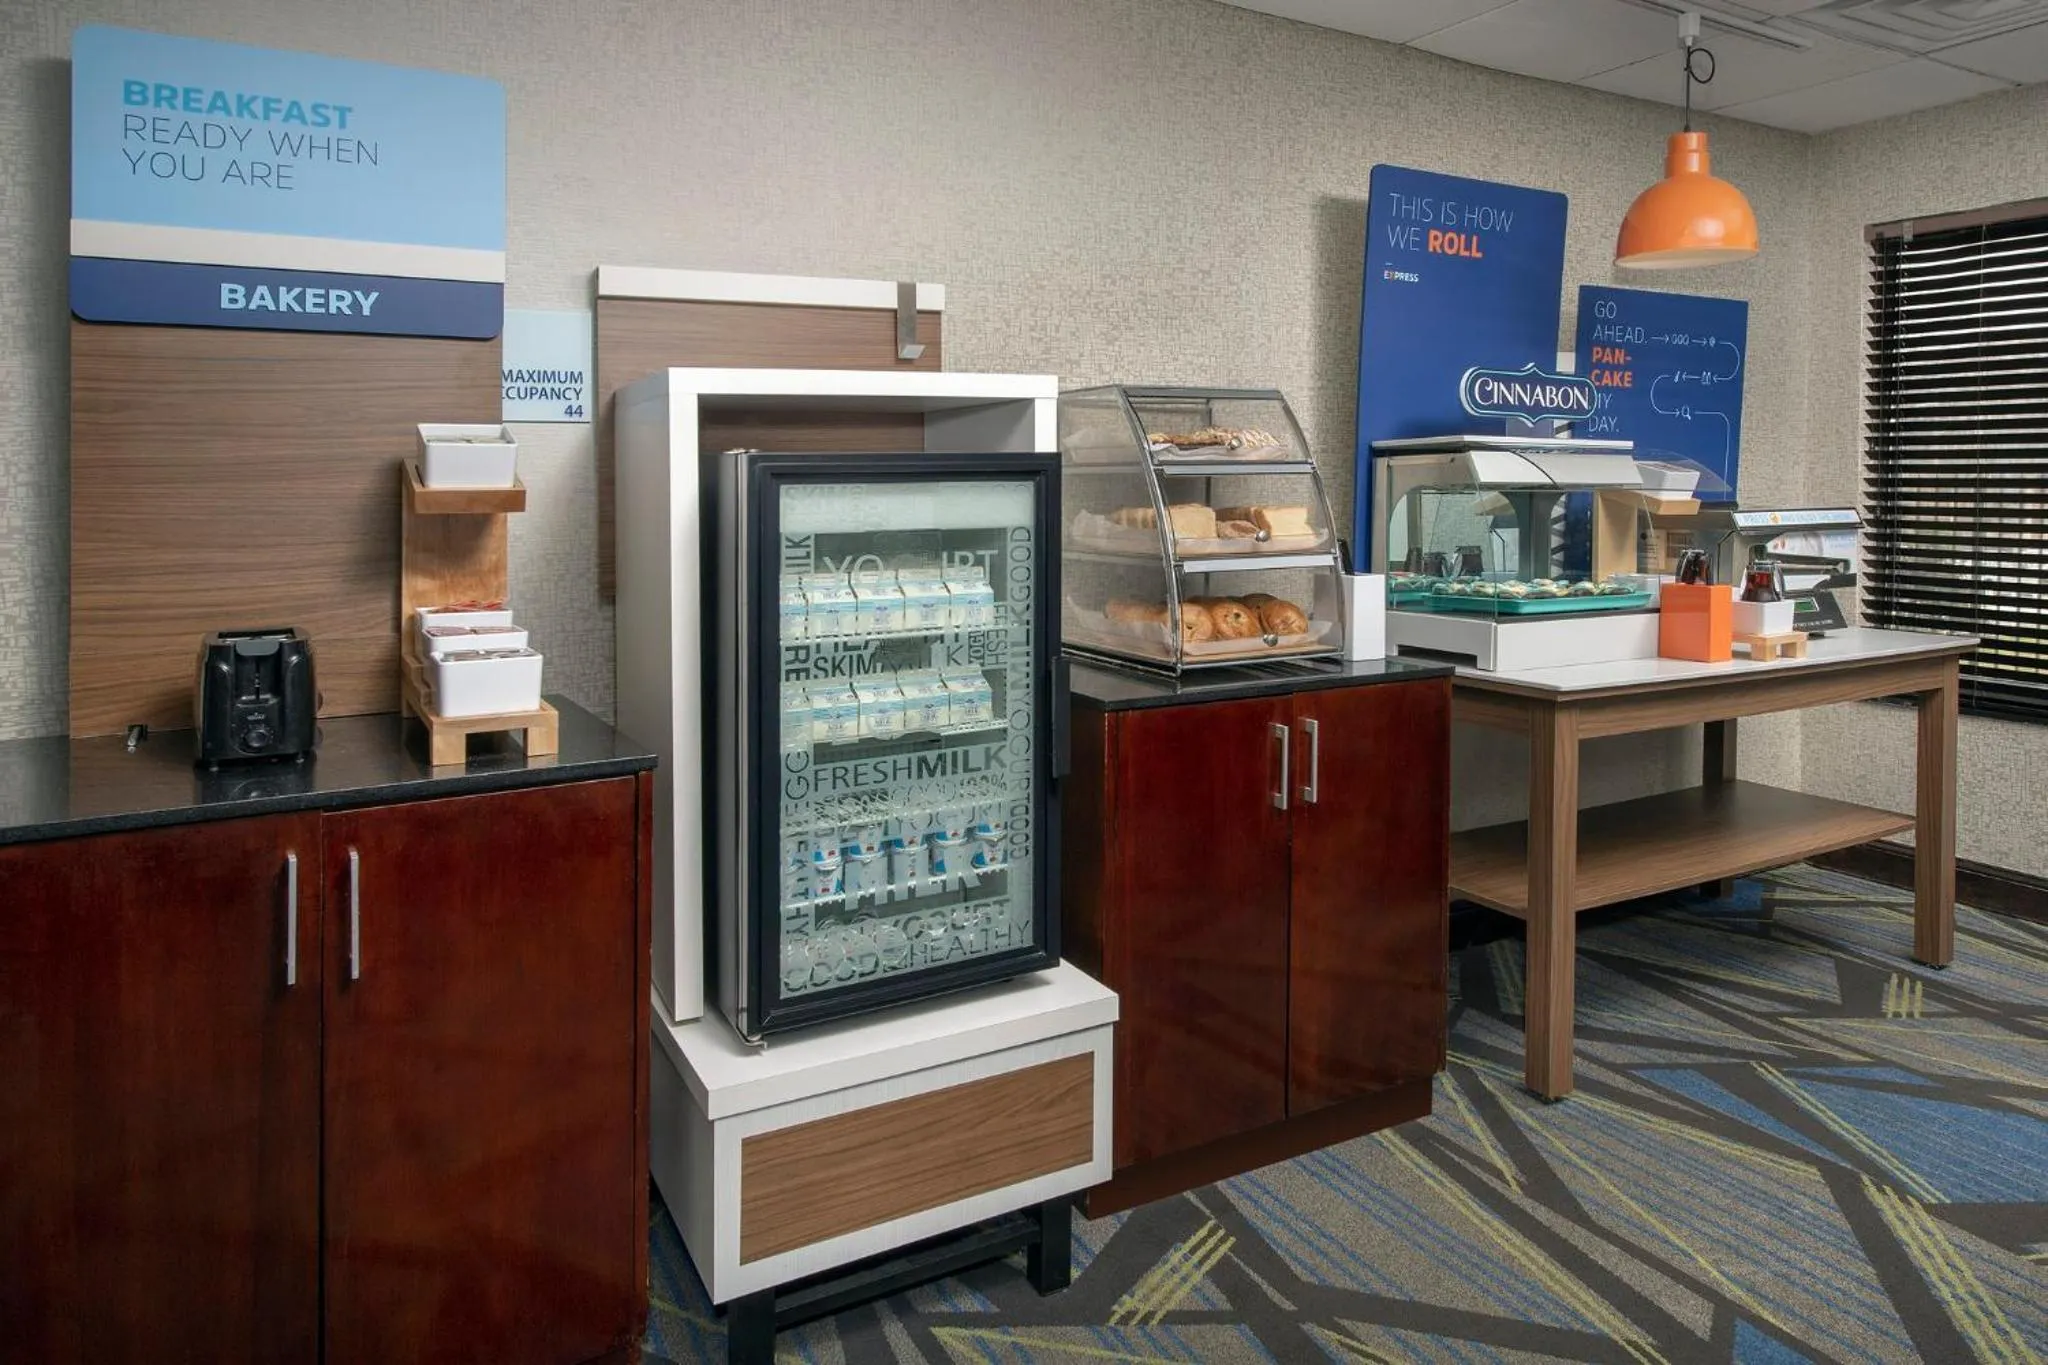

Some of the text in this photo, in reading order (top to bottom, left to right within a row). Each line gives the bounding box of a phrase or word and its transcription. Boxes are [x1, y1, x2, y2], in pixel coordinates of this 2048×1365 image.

[123, 79, 354, 130] BREAKFAST
[123, 113, 378, 166] READY WHEN
[122, 147, 294, 190] YOU ARE
[1389, 193, 1514, 232] THIS IS HOW
[1388, 224, 1484, 258] WE ROLL
[1383, 270, 1420, 282] EXPRESS
[220, 283, 380, 317] BAKERY
[1594, 300, 1617, 319] GO
[1592, 323, 1648, 344] AHEAD.
[1592, 346, 1632, 365] PAN-
[502, 368, 584, 385] MAXIMUM
[1591, 369, 1633, 388] CAKE
[1474, 376, 1589, 410] CINNABON
[564, 404, 584, 418] 44
[1588, 415, 1619, 433] DAY.
